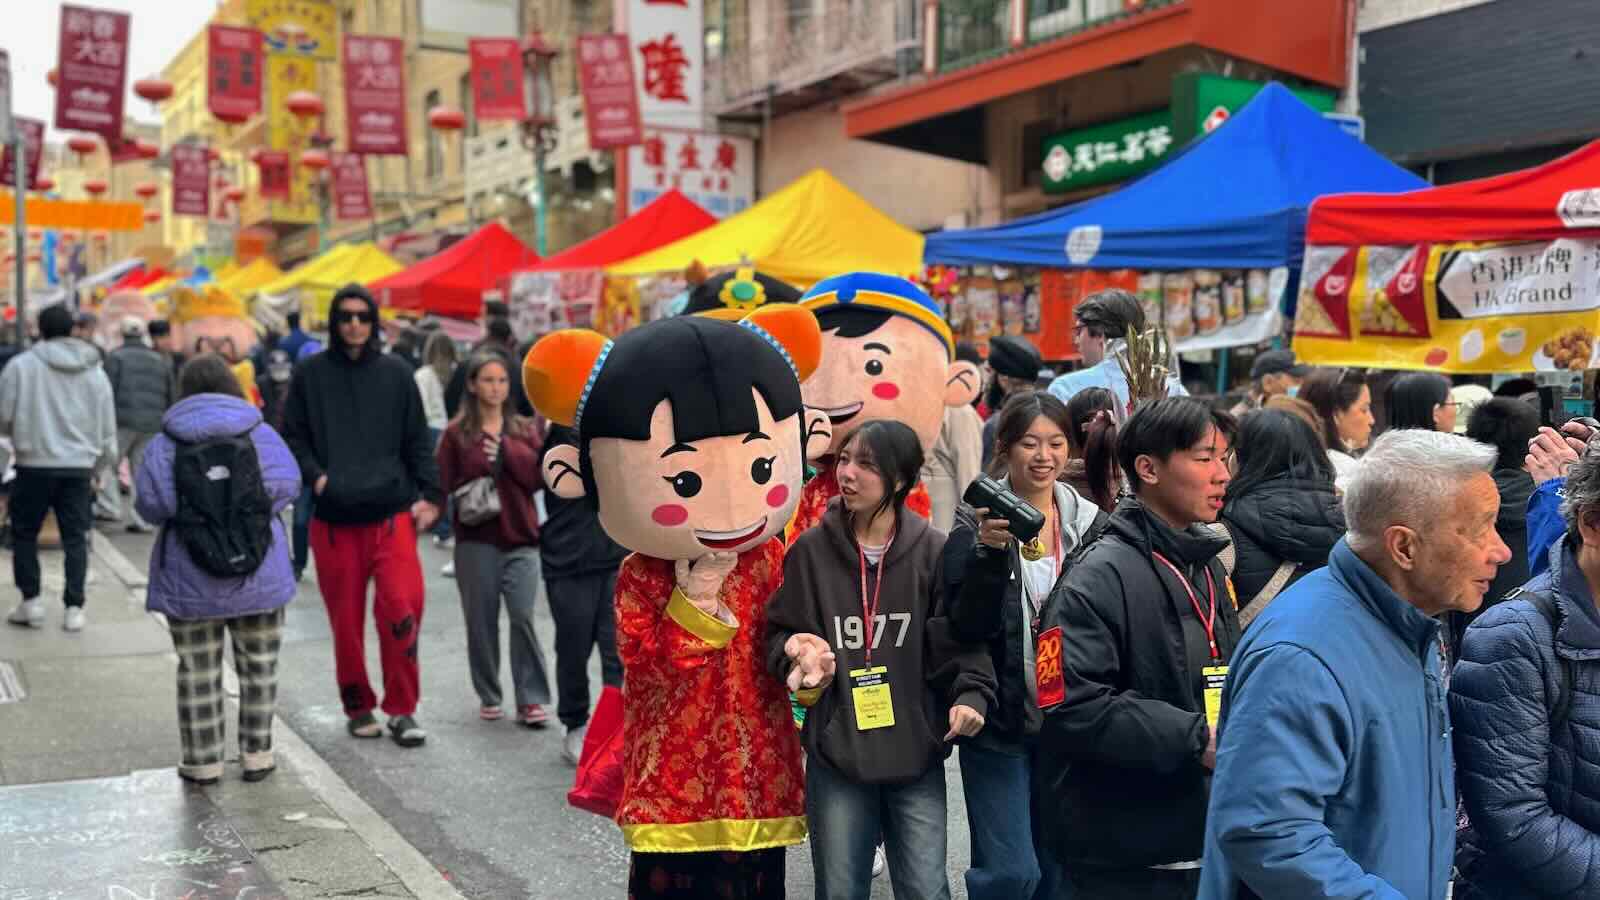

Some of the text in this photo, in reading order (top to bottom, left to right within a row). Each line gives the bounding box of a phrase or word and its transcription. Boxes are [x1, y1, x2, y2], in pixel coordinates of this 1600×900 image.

[638, 0, 690, 103] 隆
[1505, 281, 1572, 304] Brand
[834, 612, 912, 650] 1977
[1038, 635, 1060, 663] 20
[1038, 661, 1060, 685] 24
